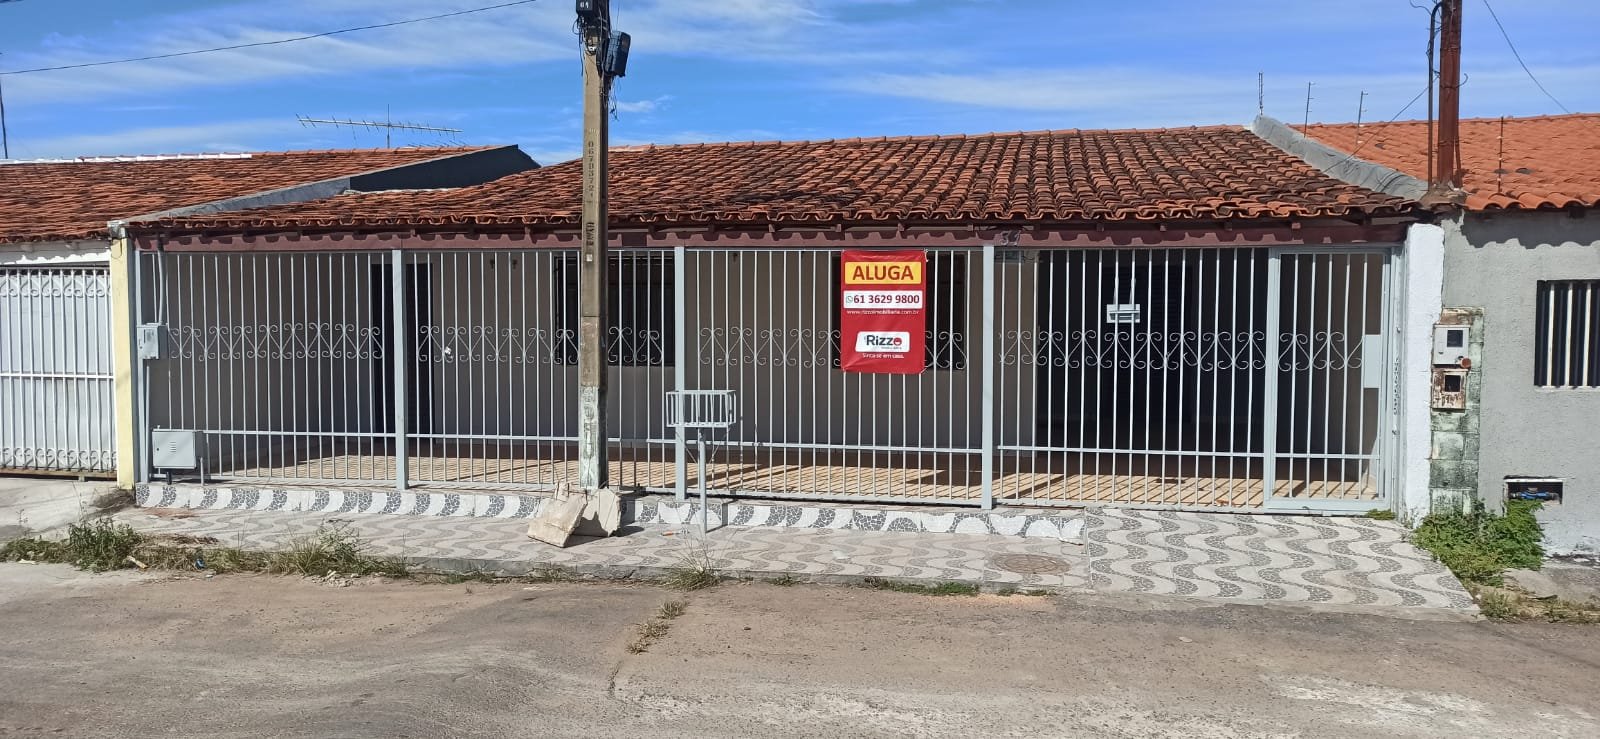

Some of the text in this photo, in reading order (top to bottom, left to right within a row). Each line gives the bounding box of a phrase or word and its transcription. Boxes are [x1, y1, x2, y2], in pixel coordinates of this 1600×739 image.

[852, 265, 914, 281] ALUGA
[853, 294, 920, 304] 61 3629 9800
[866, 334, 903, 346] Rizzo
